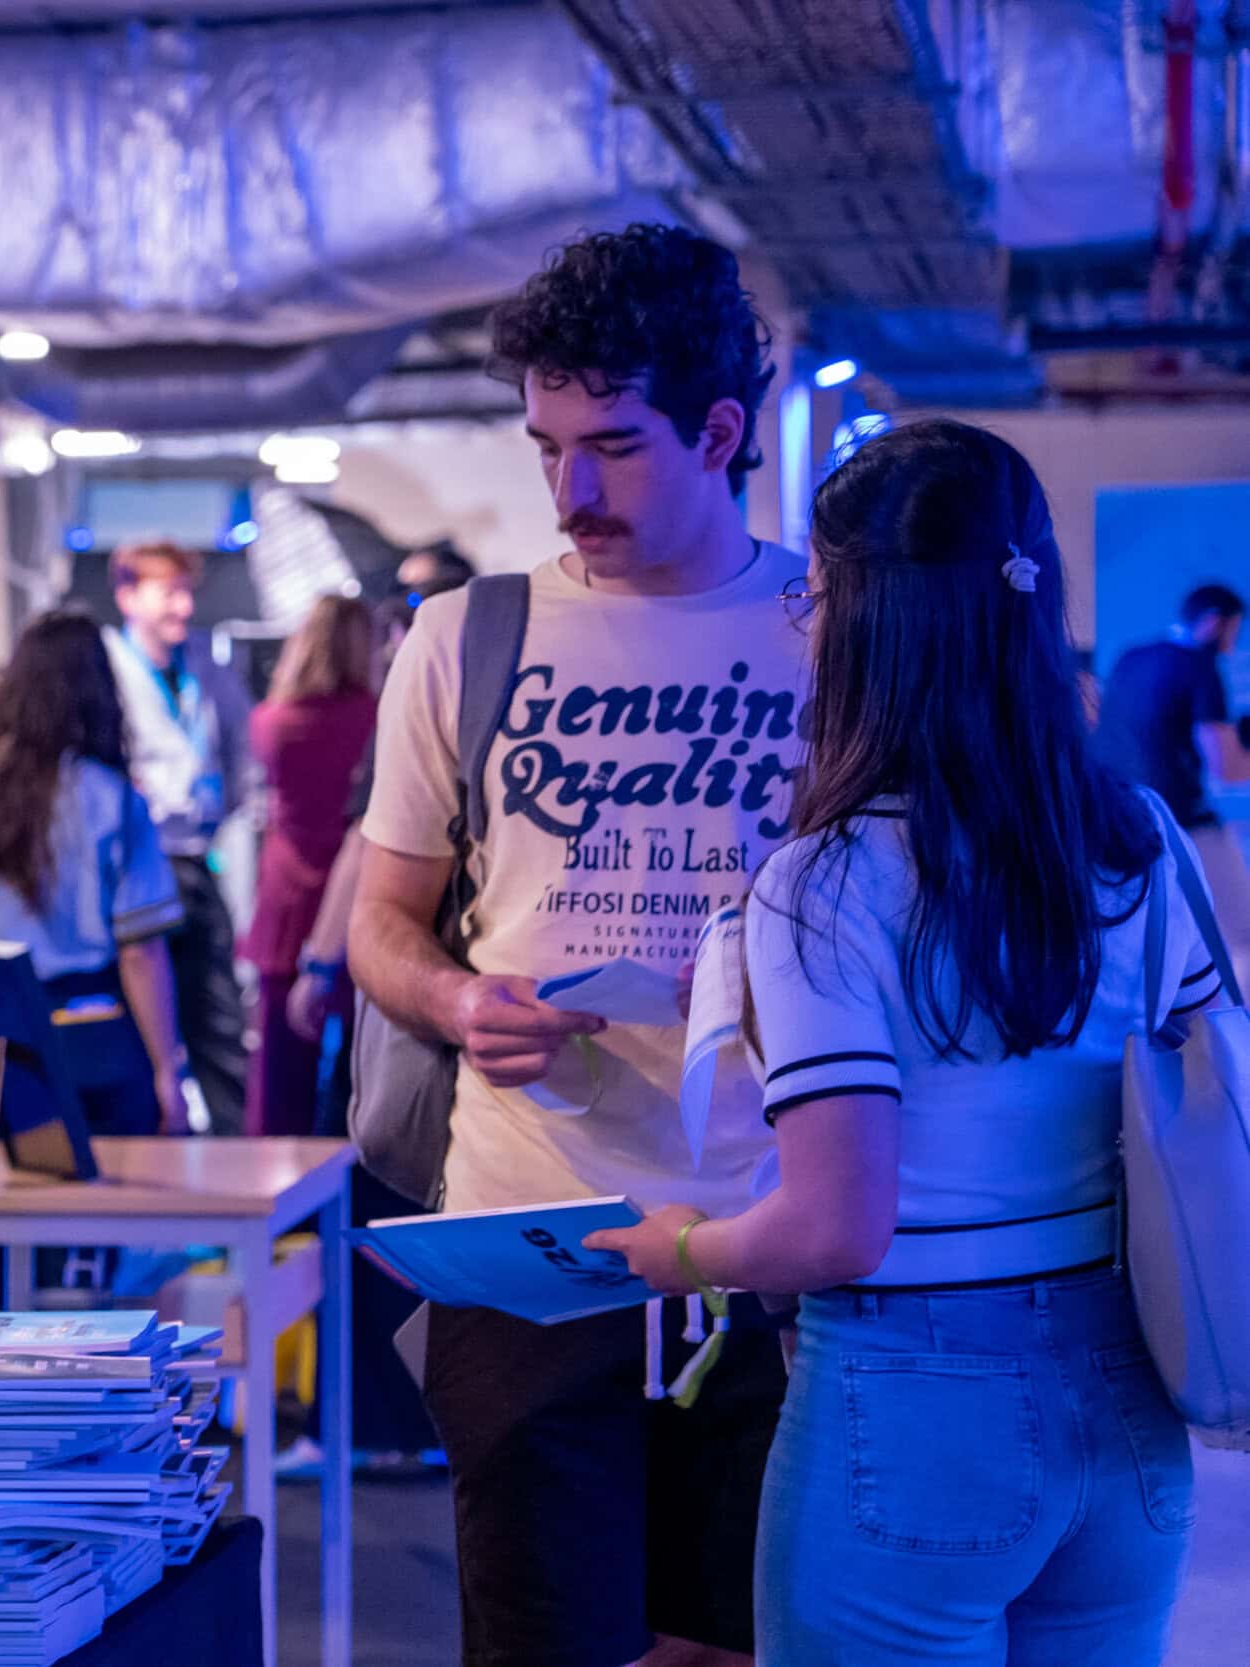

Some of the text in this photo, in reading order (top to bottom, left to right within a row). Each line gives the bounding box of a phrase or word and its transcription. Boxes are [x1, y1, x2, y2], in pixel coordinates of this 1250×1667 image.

[563, 828, 749, 873] Built To Last
[632, 892, 710, 916] DENIM
[565, 943, 699, 959] MANUFACTUR
